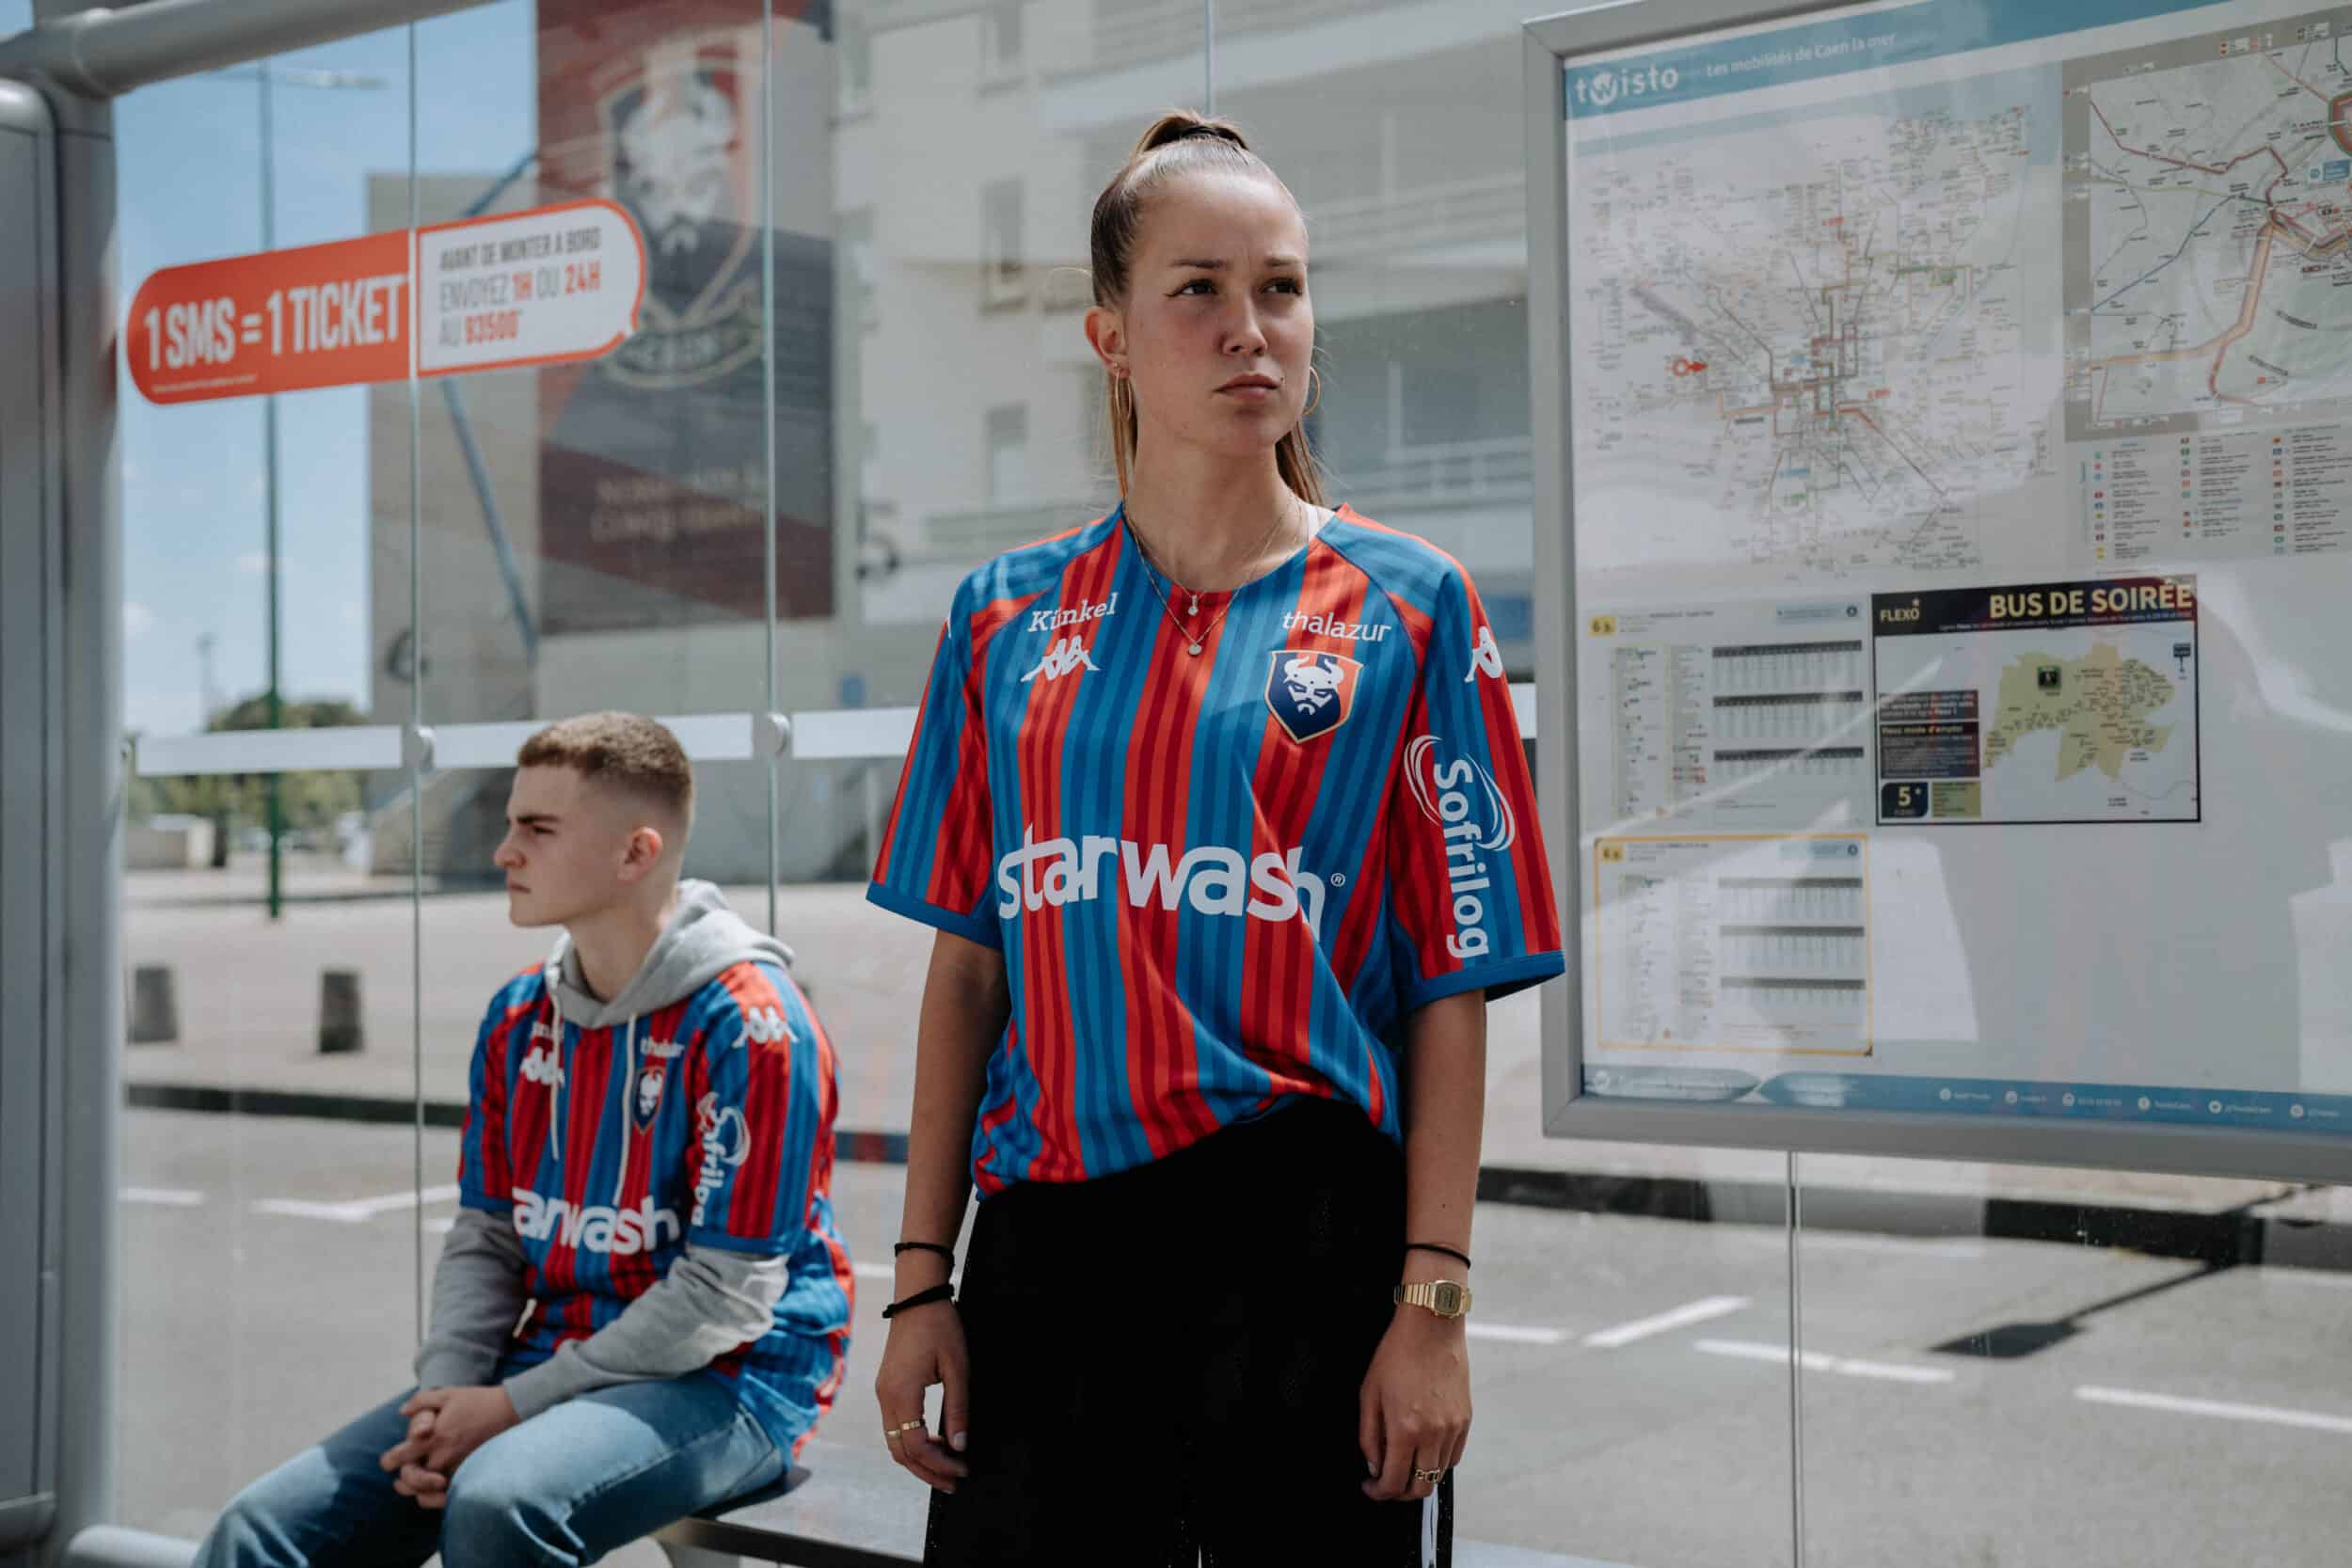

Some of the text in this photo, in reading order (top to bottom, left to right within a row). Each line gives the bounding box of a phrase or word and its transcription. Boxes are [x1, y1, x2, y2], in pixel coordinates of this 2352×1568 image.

[1795, 46, 1812, 63] de
[1575, 64, 1678, 105] twisto
[481, 242, 497, 266] DE
[501, 234, 551, 262] MONTER
[565, 227, 601, 253] BORD
[439, 261, 601, 313] ENVOYEZ 1H OU 24H
[144, 307, 159, 372] 1
[166, 297, 235, 369] SMS
[267, 289, 281, 355] 1
[288, 274, 408, 352] TICKET
[1990, 578, 2193, 619] BUS DE SOIRÉE
[1281, 611, 1391, 643] thalazur
[1434, 758, 1490, 959] Sofrilog
[512, 1187, 680, 1255] arwash
